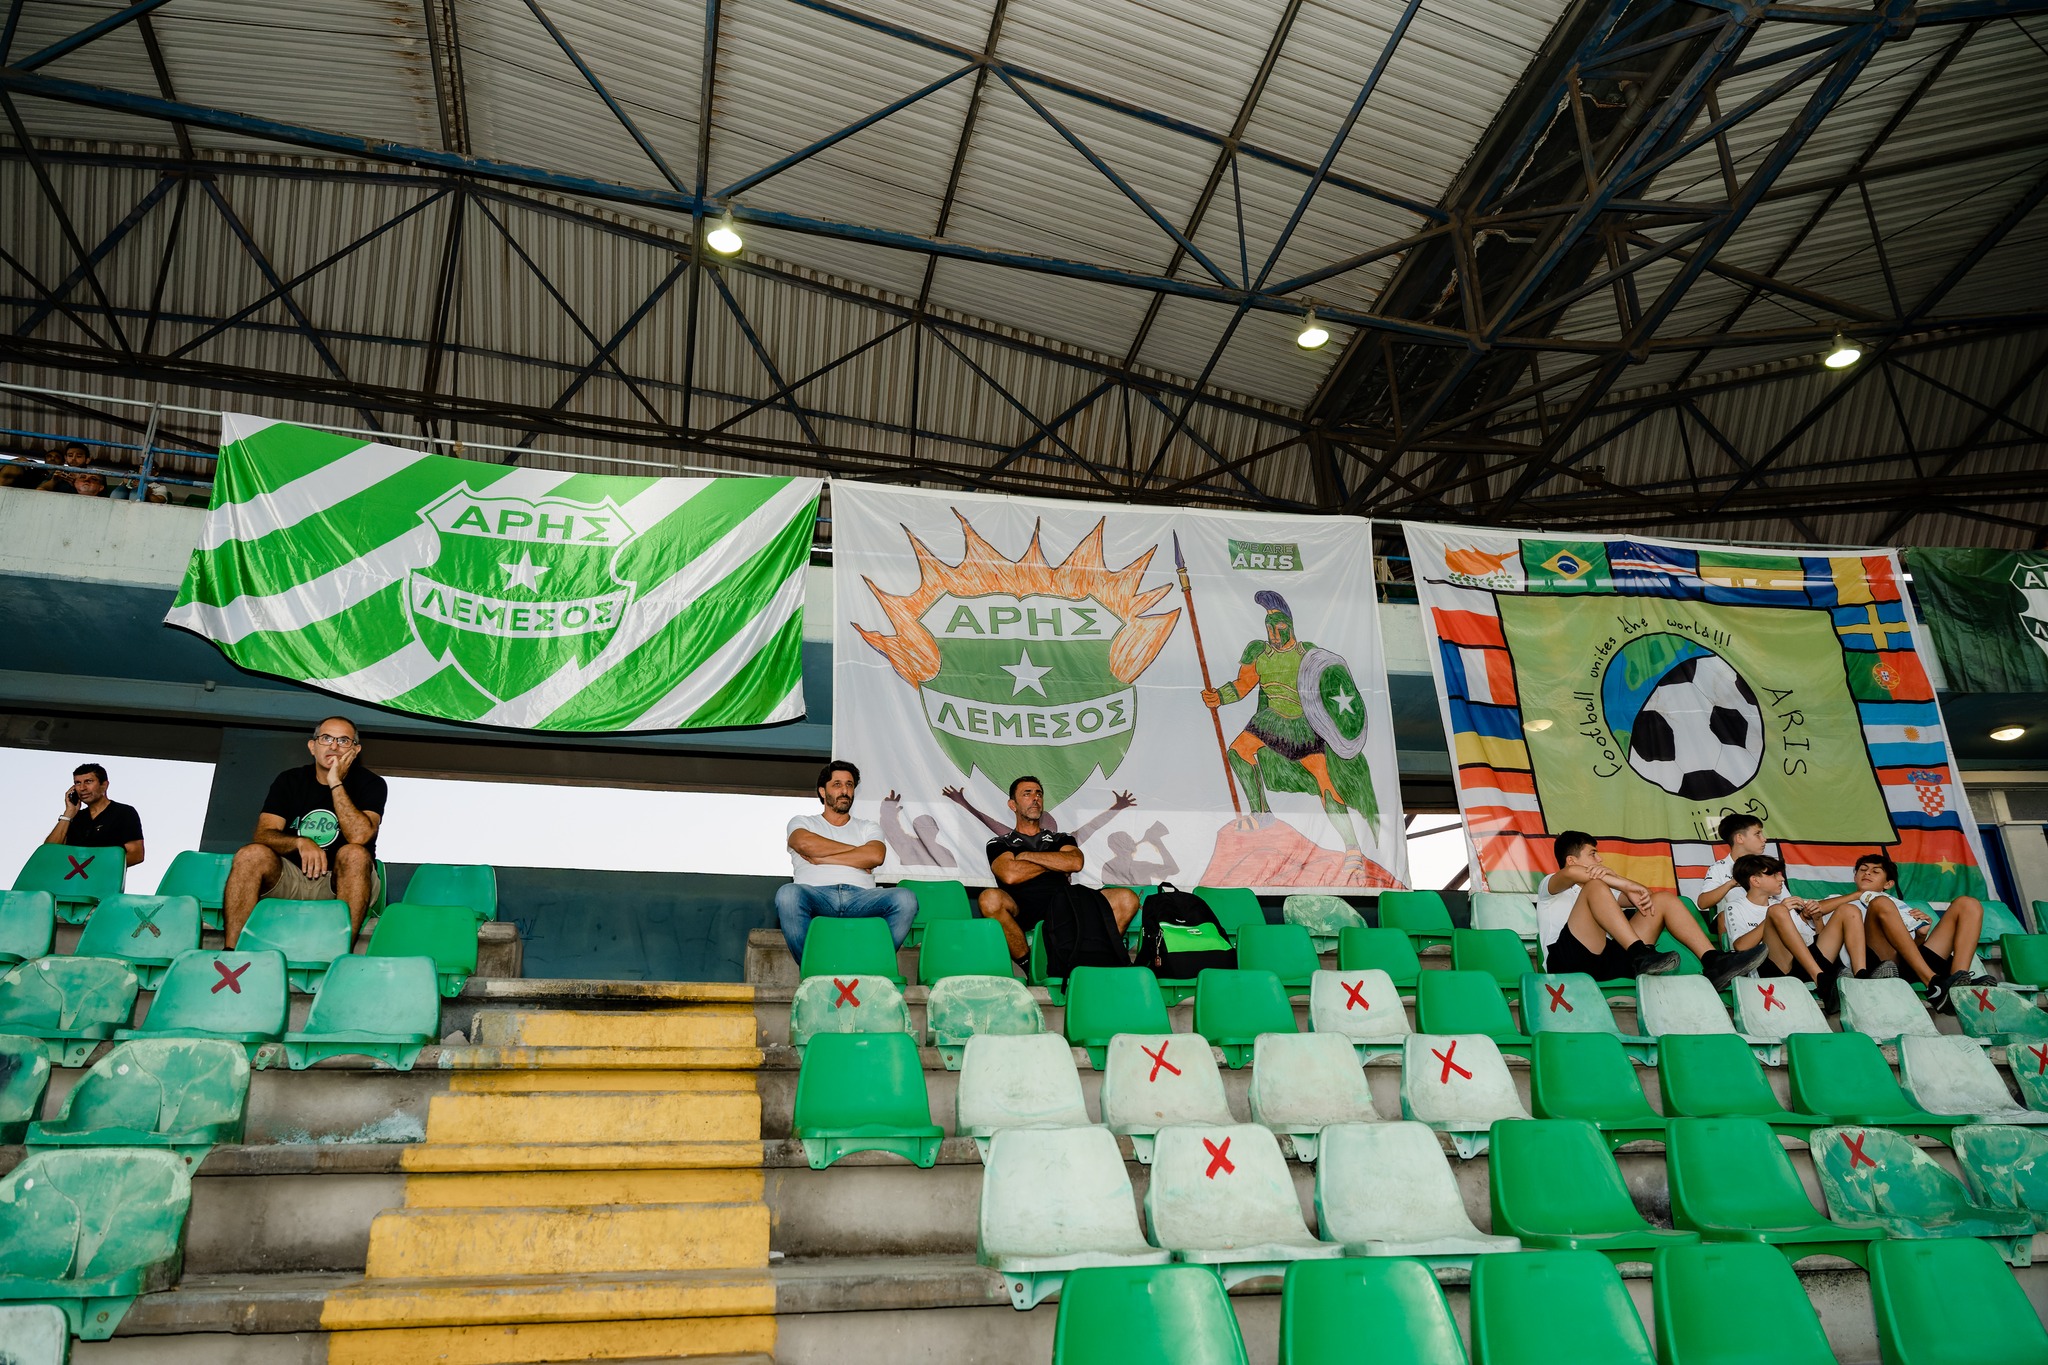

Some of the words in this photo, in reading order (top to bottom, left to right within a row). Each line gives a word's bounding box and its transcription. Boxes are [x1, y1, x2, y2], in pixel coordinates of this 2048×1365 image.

[450, 505, 611, 542] ΑΡΗΣ
[1232, 553, 1294, 570] ARIS
[1236, 541, 1260, 552] WE
[1262, 543, 1294, 555] ARE
[420, 587, 614, 632] ΛΕΜΕΣΟΣ
[945, 604, 1102, 636] ΑΡΗΣ
[1590, 636, 1617, 678] unites
[1617, 615, 1649, 634] the
[937, 699, 1127, 738] ΛΕΜΕΣΟΣ
[1761, 686, 1810, 776] ARIS
